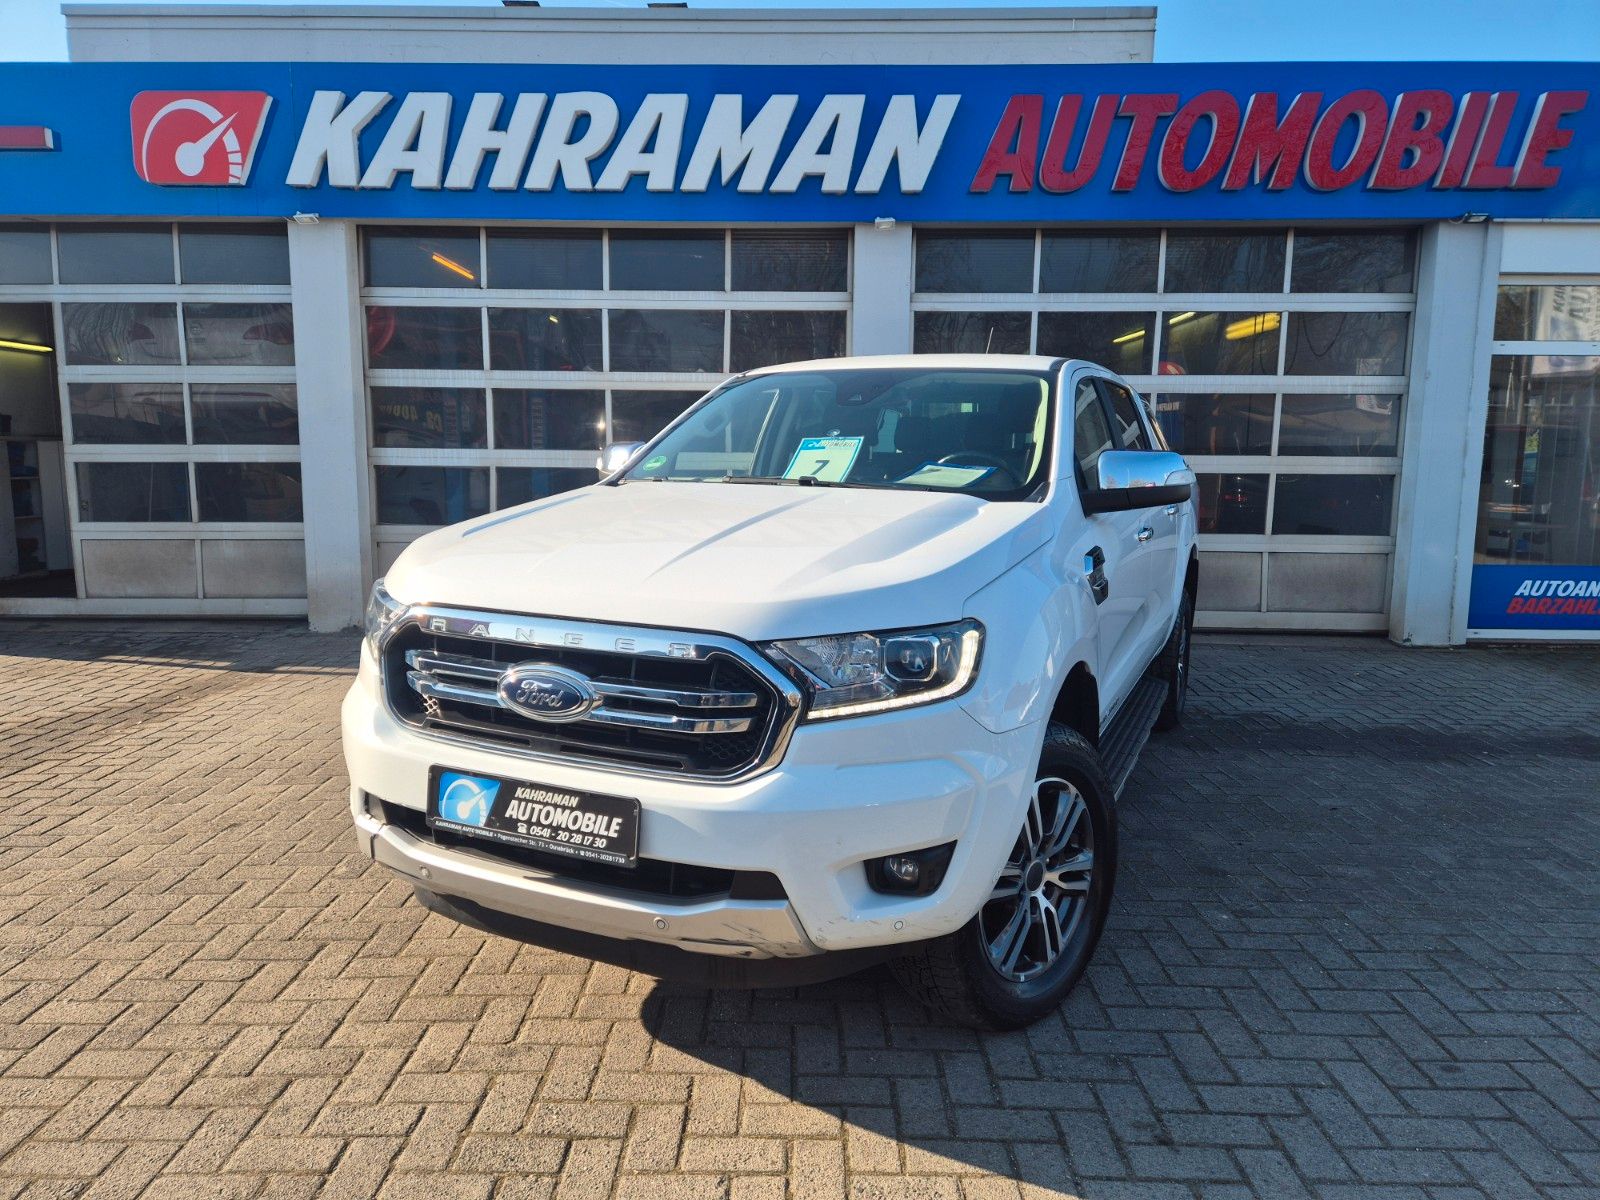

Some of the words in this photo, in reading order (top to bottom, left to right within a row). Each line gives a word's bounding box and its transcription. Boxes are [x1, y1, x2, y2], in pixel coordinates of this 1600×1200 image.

[285, 90, 962, 194] KAHRAMAN
[969, 89, 1589, 194] AUTOMOBILE
[810, 460, 830, 475] 7
[1506, 597, 1600, 615] BARZAHL
[430, 618, 693, 658] RANGER
[516, 680, 563, 708] Ford
[515, 787, 579, 807] KAHRAMAN
[505, 800, 622, 837] AUTOMOBILE
[529, 825, 551, 838] 0541
[556, 830, 570, 841] 20
[569, 833, 583, 844] 28
[582, 835, 593, 846] 17
[593, 838, 607, 849] 30
